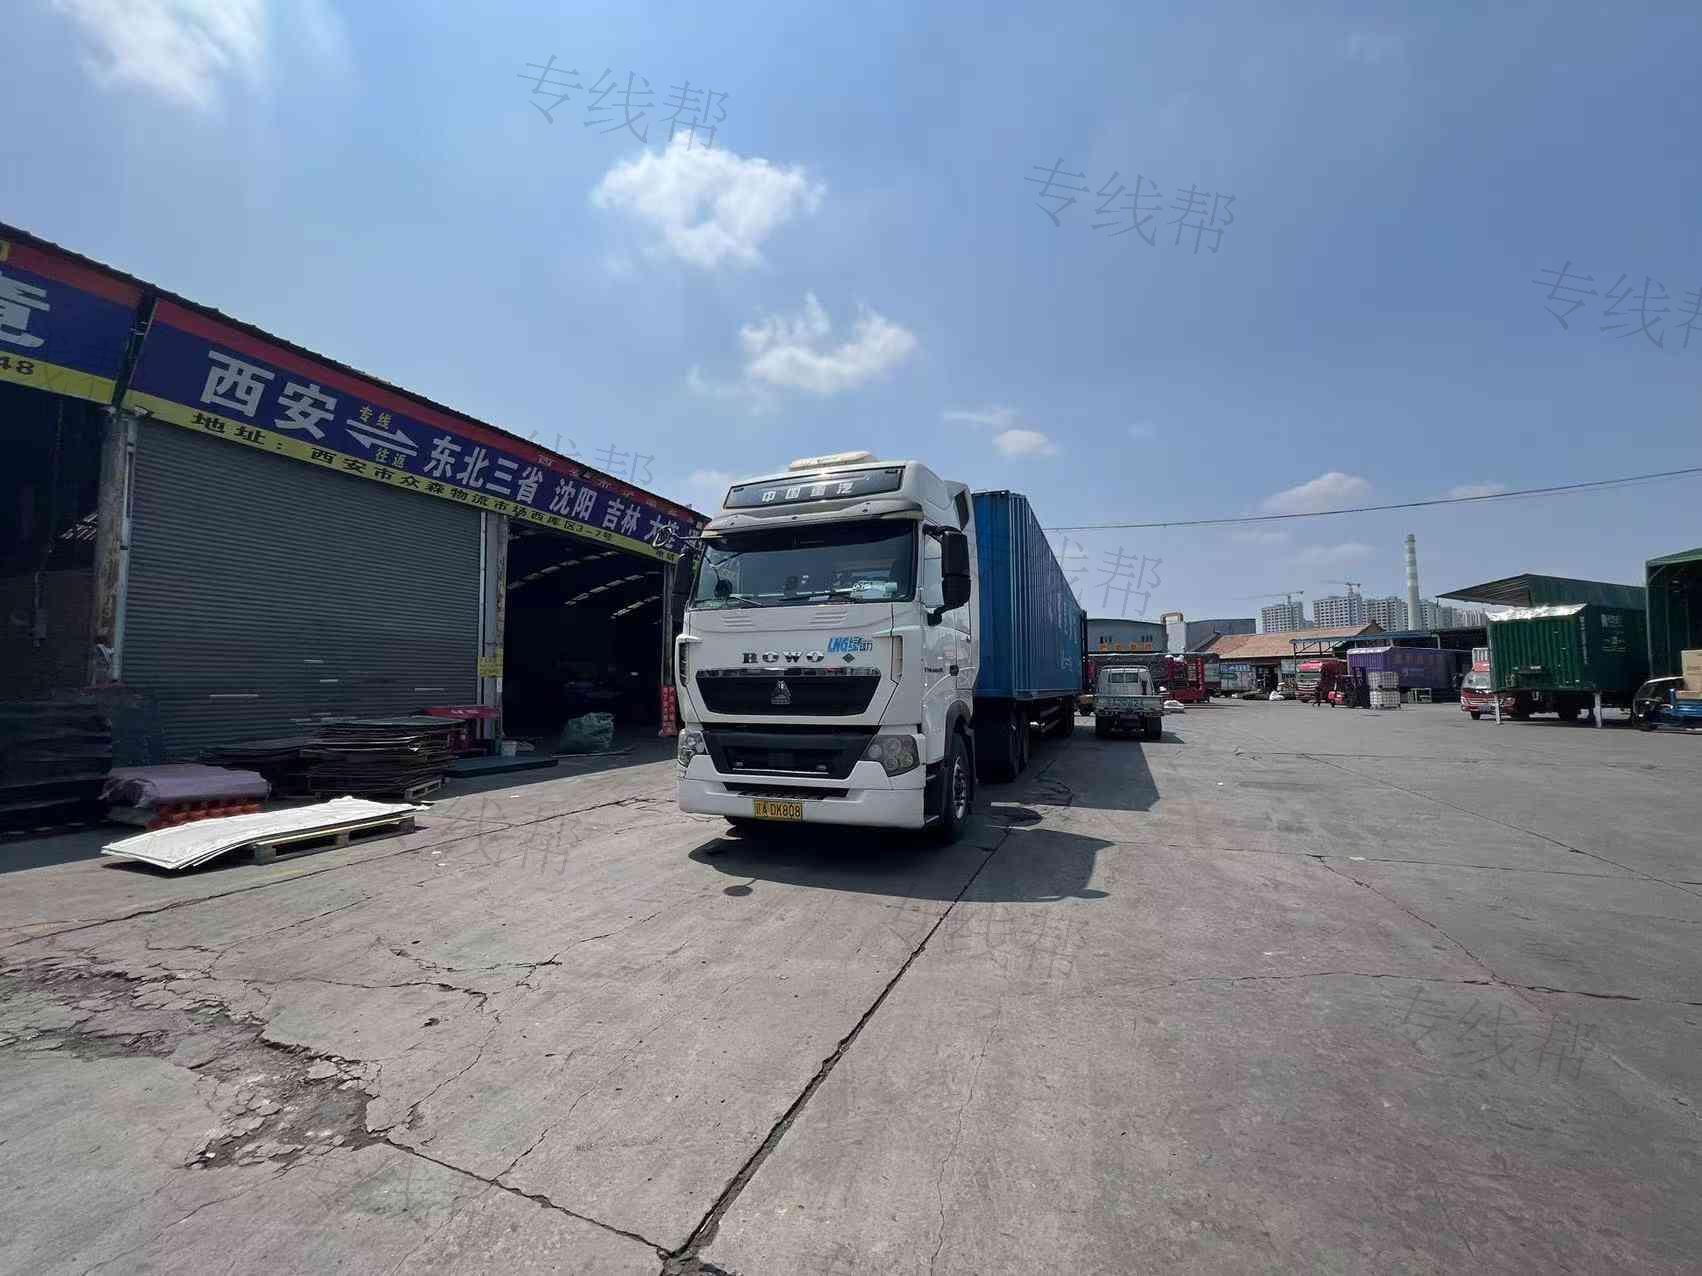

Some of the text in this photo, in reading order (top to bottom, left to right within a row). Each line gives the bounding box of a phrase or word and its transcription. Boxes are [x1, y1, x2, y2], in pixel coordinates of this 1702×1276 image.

[200, 350, 338, 440] 西安
[424, 436, 543, 505] 东北三省
[550, 477, 599, 522] 沈阳
[602, 498, 642, 536] 吉林
[359, 405, 393, 430] 专线
